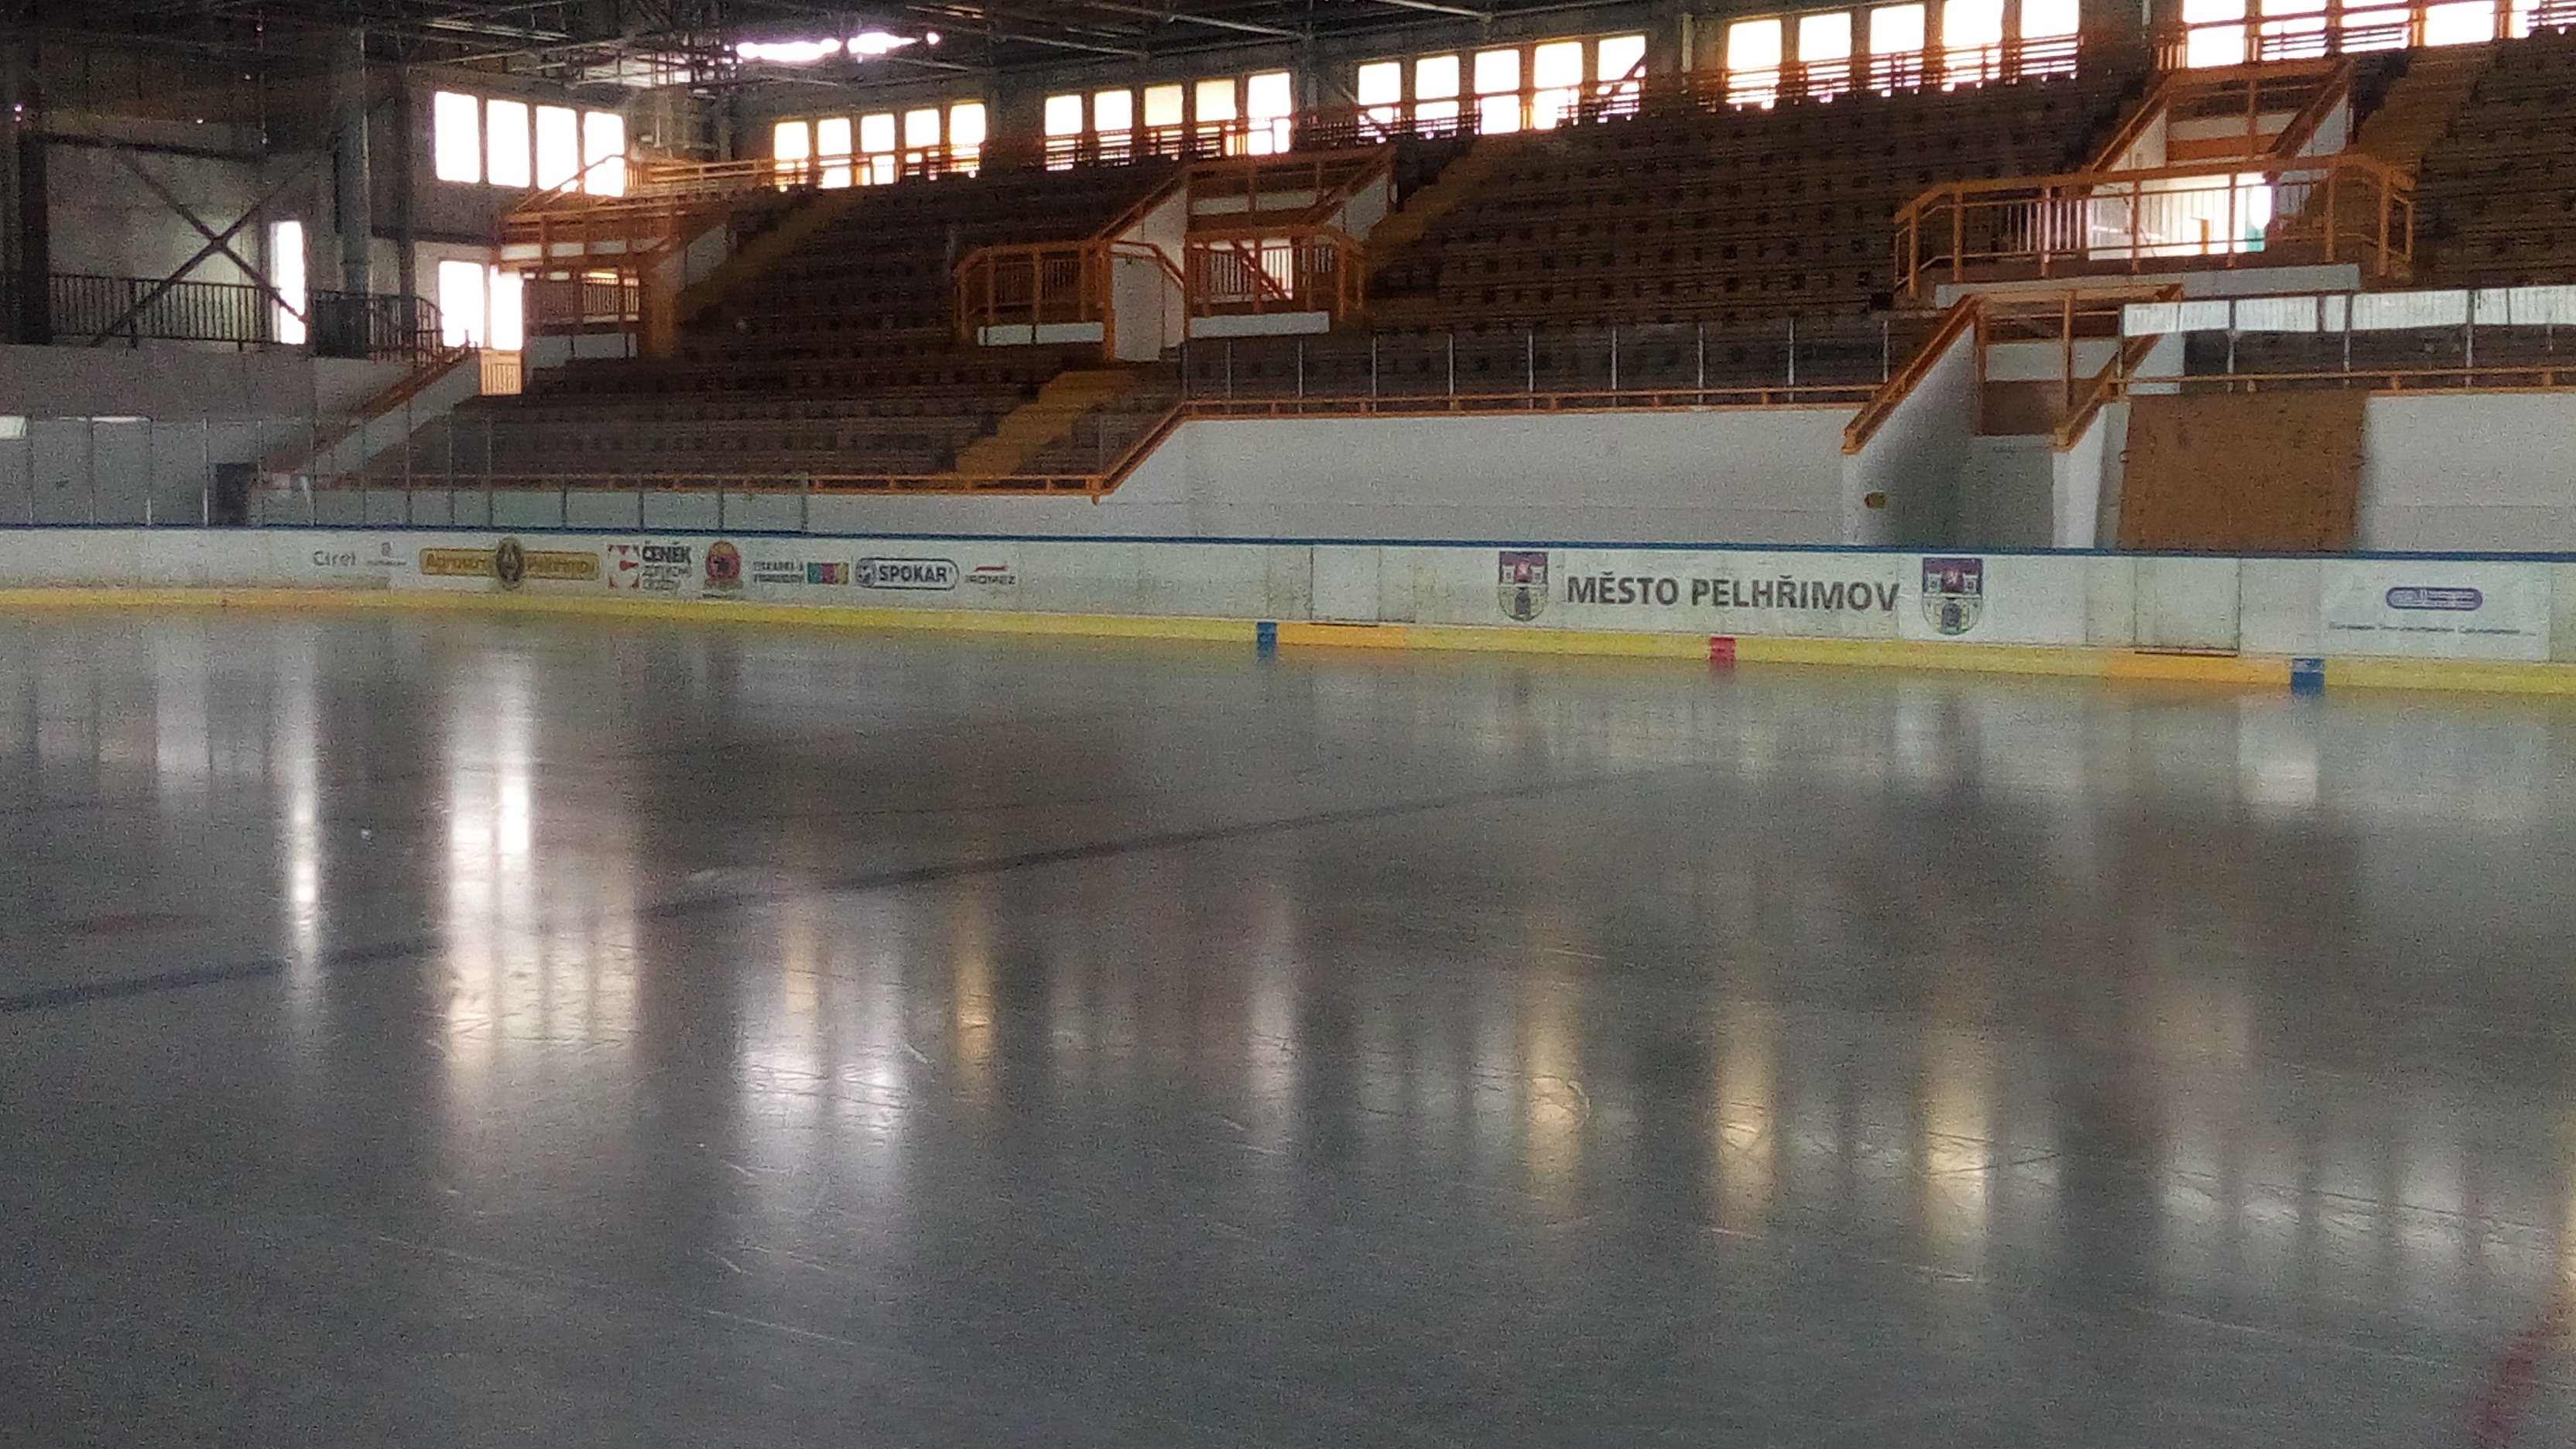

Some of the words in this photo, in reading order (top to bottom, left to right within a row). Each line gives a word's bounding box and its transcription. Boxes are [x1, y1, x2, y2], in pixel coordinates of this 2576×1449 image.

[879, 564, 947, 582] SPOKAR
[1567, 571, 1679, 605] MĚSTO
[1691, 574, 1900, 611] PELHŘIMOV
